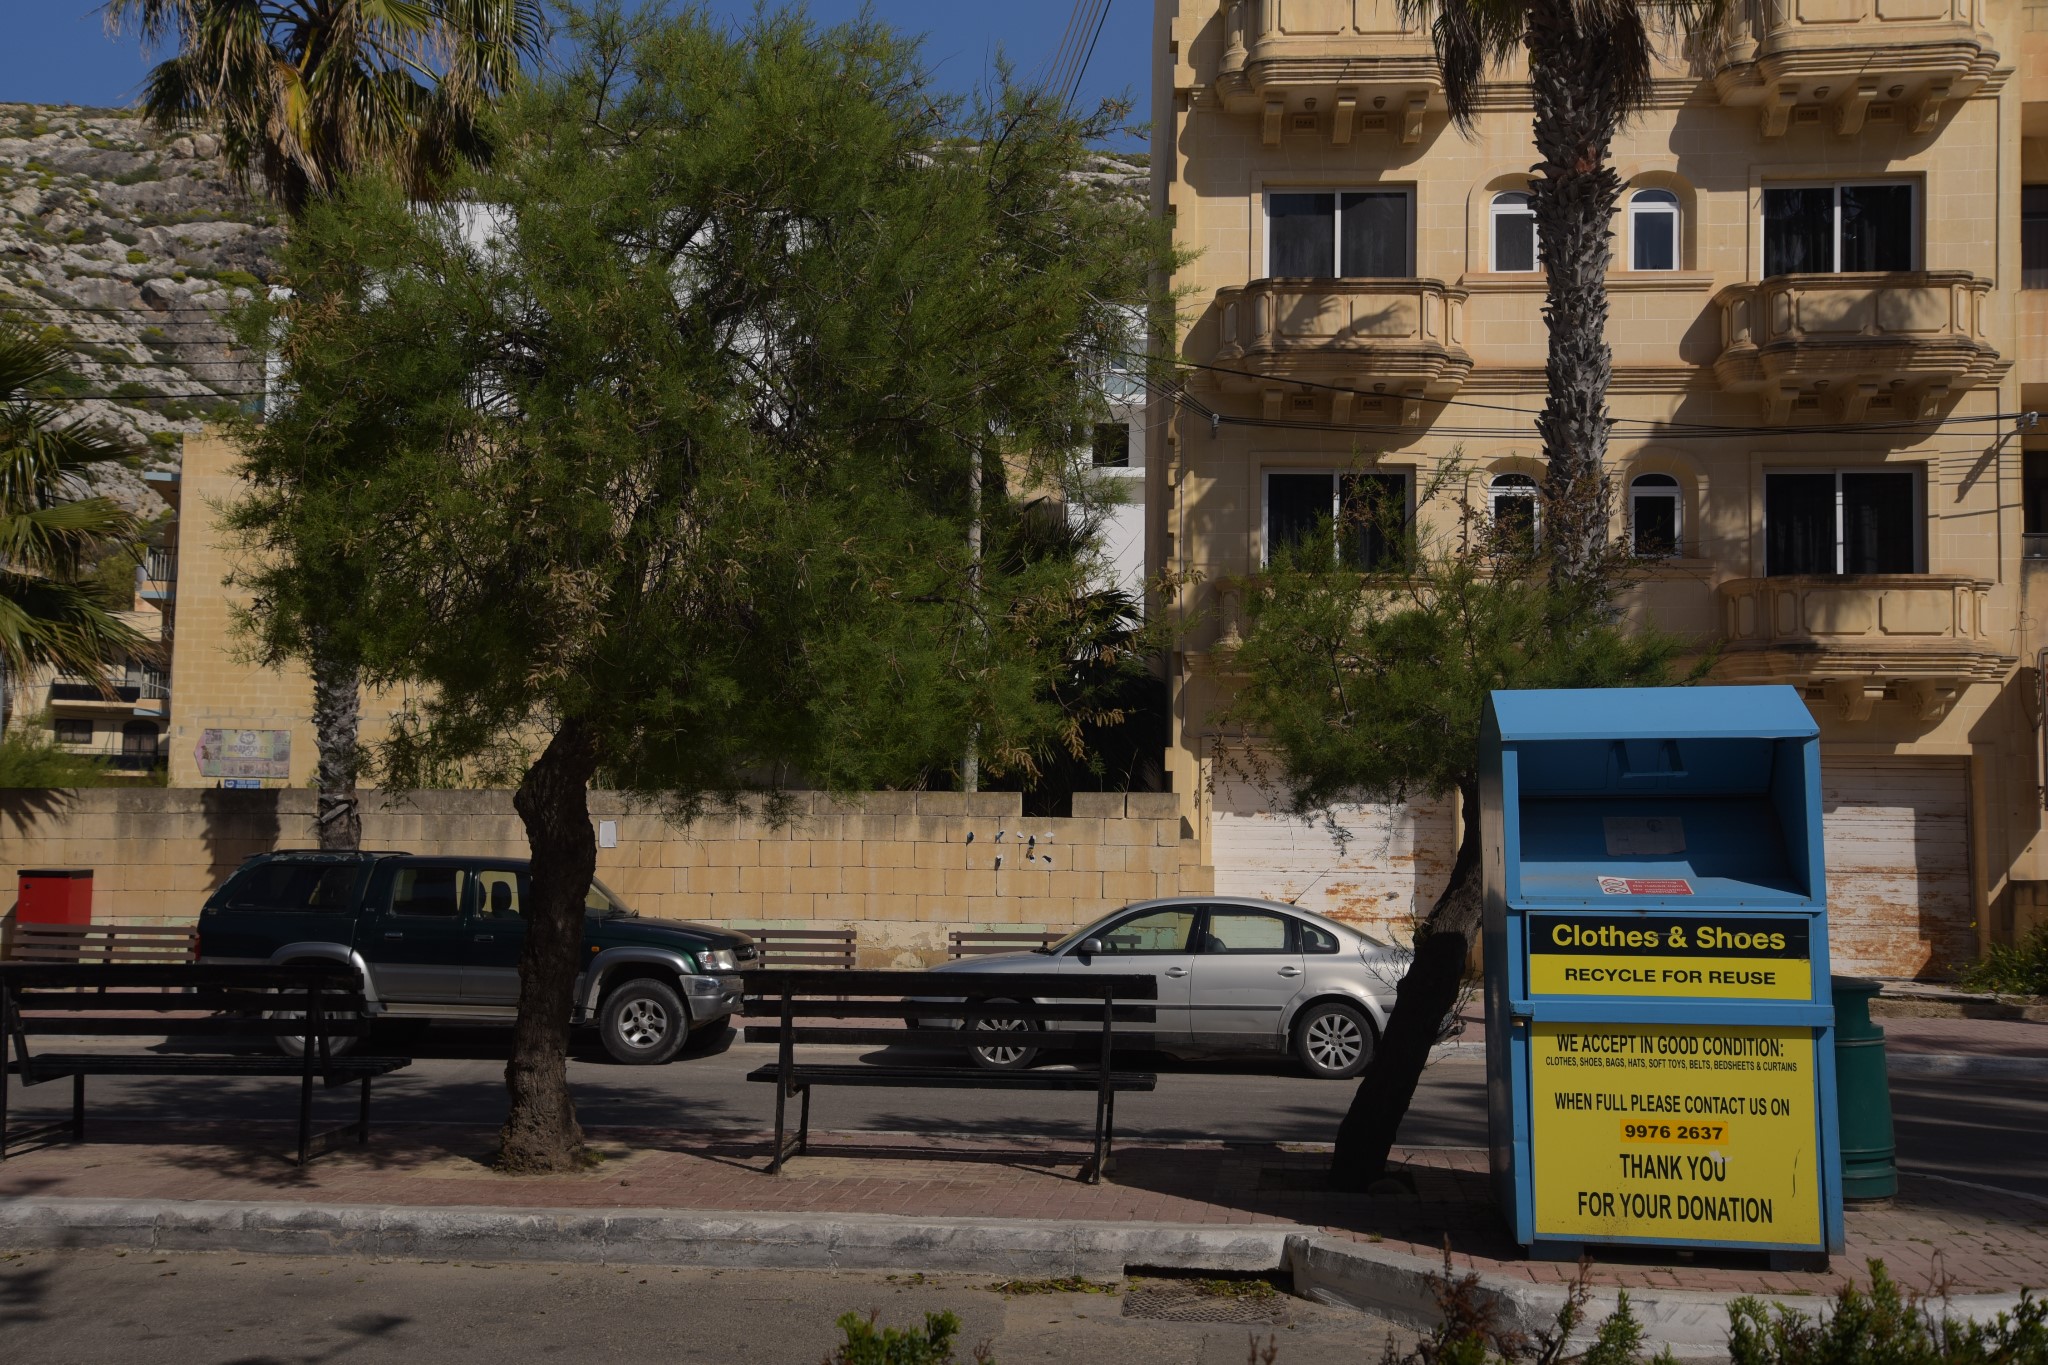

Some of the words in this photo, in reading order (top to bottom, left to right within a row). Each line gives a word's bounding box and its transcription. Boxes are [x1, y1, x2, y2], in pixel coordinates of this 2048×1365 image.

[1552, 924, 1660, 948] Clothes
[1667, 925, 1689, 948] &
[1696, 926, 1786, 950] Shoes
[1565, 968, 1656, 983] RECYCLE
[1662, 969, 1703, 984] FOR
[1708, 970, 1776, 985] REUSE
[1556, 1033, 1578, 1052] WE
[1582, 1034, 1636, 1054] ACCEPT
[1640, 1035, 1653, 1054] IN
[1657, 1035, 1699, 1055] GOOD
[1703, 1037, 1784, 1057] CONDITION:
[1545, 1056, 1579, 1067] CLOTHES,
[1579, 1056, 1605, 1068] SHOES,
[1605, 1057, 1627, 1068] BAGS,
[1627, 1058, 1647, 1069] HATS,
[1648, 1058, 1667, 1069] SOFT
[1668, 1058, 1688, 1070] TOYS,
[1689, 1060, 1712, 1071] BELTS,
[1713, 1060, 1755, 1071] BEDSHEETS
[1756, 1061, 1761, 1071] &
[1763, 1061, 1798, 1072] CURTAINS
[1554, 1092, 1592, 1111] WHEN
[1595, 1093, 1627, 1112] FULL
[1631, 1094, 1681, 1113] PLEASE
[1684, 1095, 1745, 1115] CONTACT
[1749, 1097, 1767, 1116] US
[1770, 1098, 1790, 1117] ON
[1624, 1124, 1671, 1139] 9976
[1677, 1125, 1723, 1140] 2637
[1619, 1153, 1683, 1180] THANK
[1686, 1155, 1726, 1182] YOU
[1578, 1191, 1615, 1217] FOR
[1619, 1193, 1672, 1219] YOUR
[1677, 1195, 1773, 1224] DONATION
